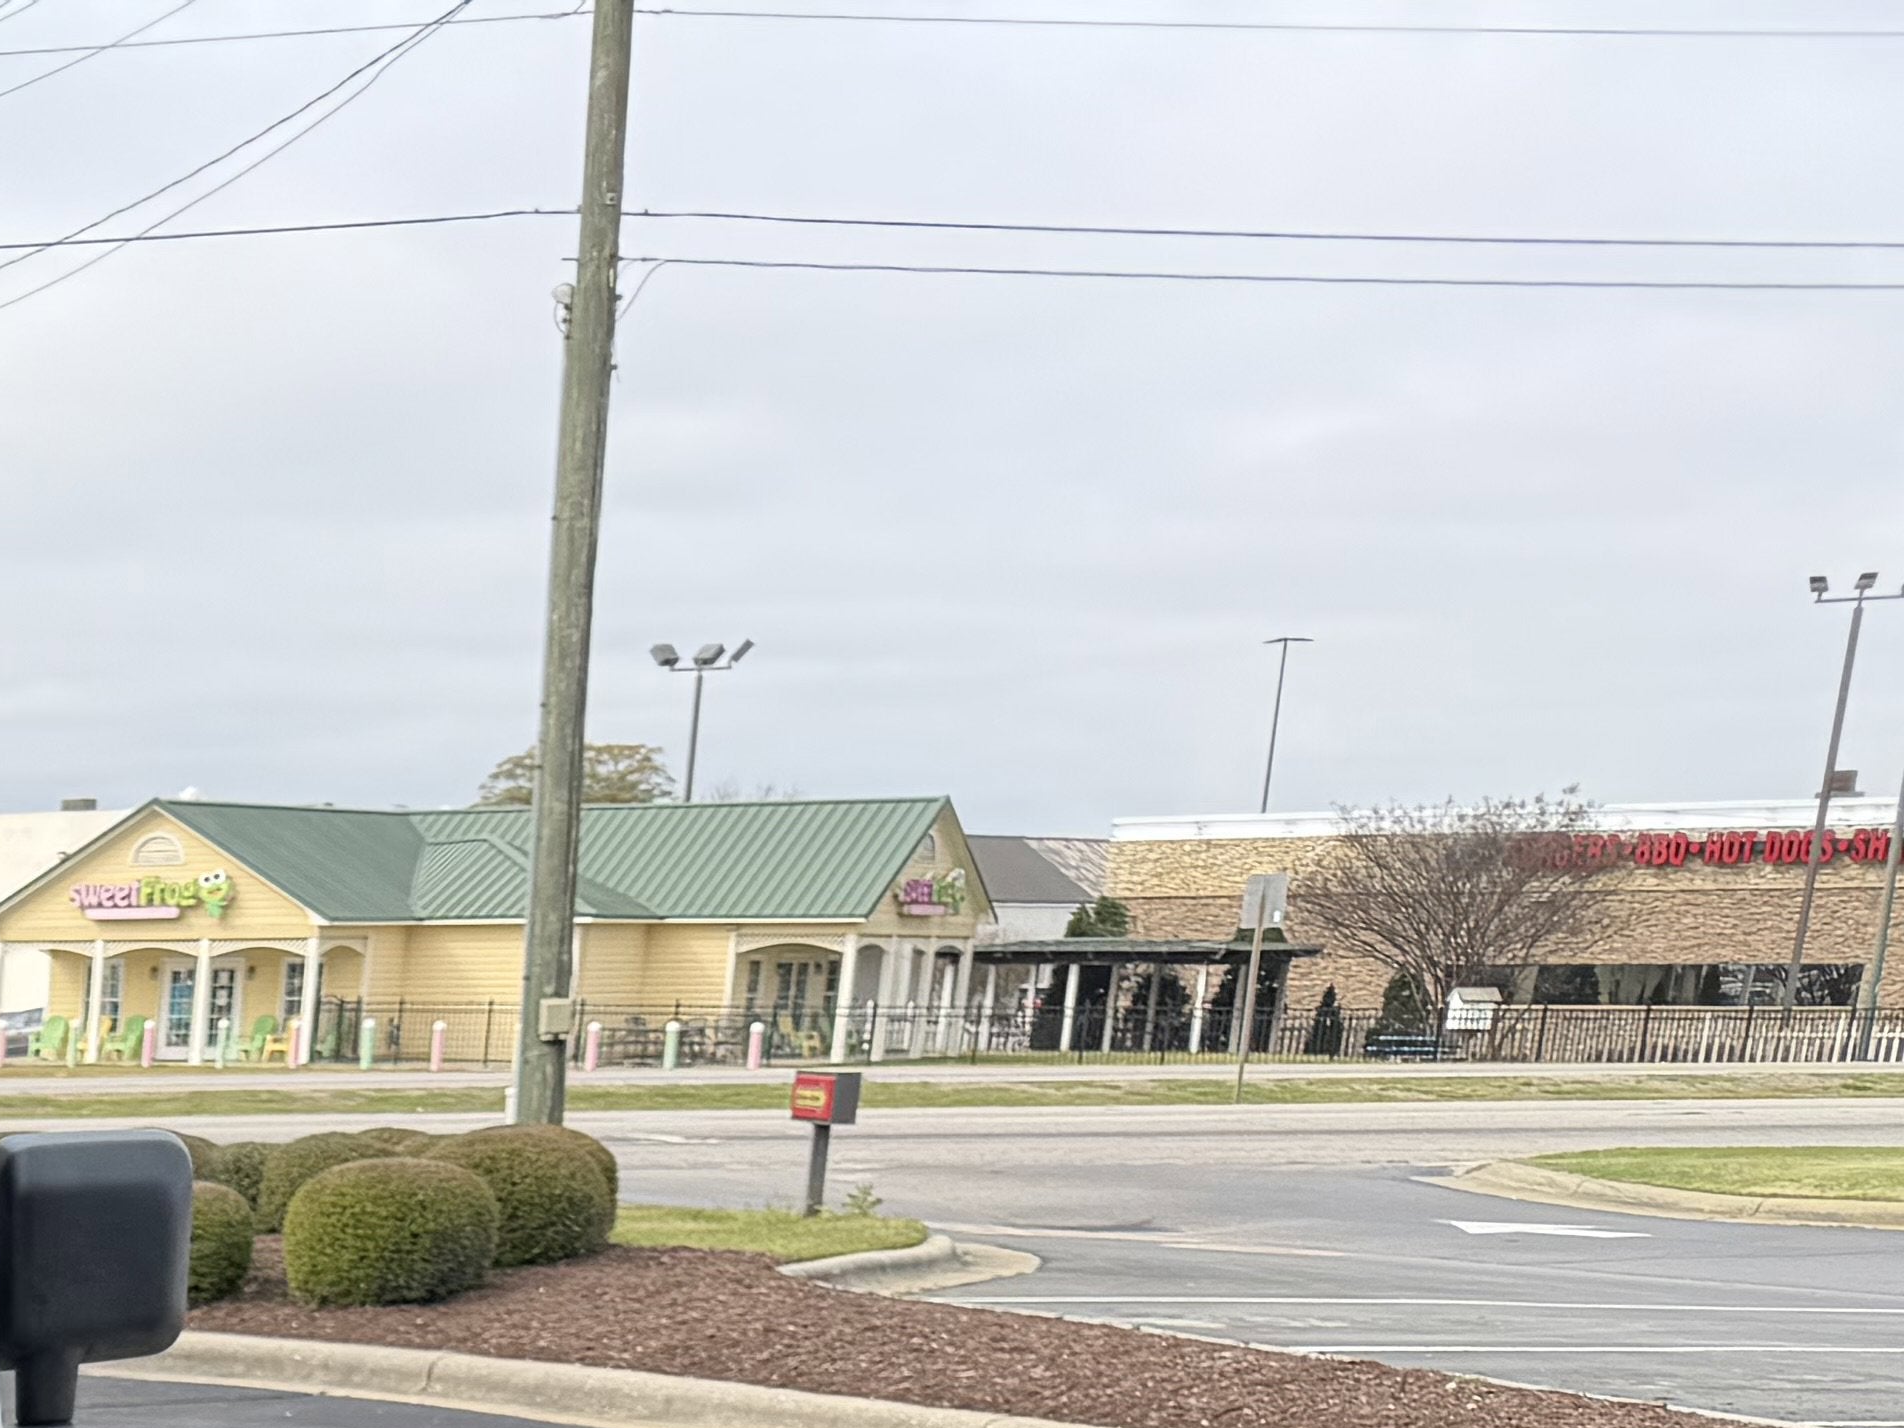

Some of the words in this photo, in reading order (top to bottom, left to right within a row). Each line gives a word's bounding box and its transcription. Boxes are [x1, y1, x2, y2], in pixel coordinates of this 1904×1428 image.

[1635, 832, 1690, 866] BBQ
[1704, 830, 1758, 864] HOT
[1763, 828, 1835, 864] DOGS
